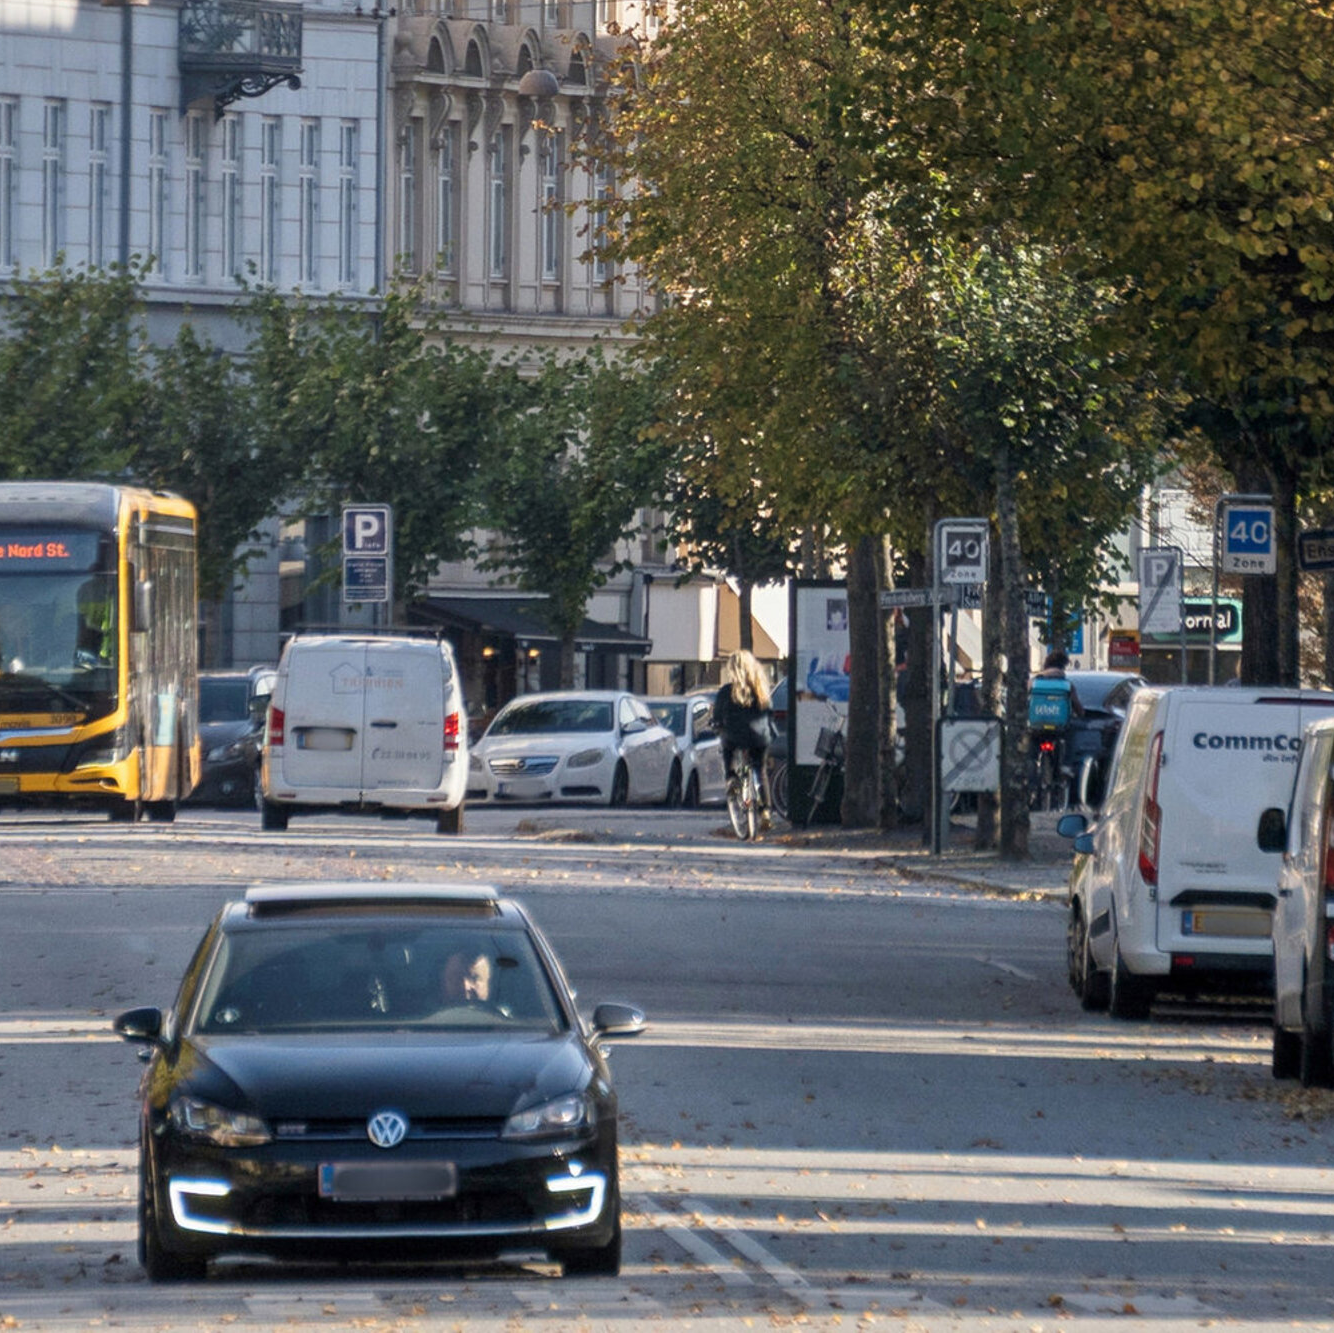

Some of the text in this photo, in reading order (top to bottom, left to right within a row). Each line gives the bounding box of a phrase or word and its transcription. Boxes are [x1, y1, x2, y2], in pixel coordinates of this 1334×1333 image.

[355, 514, 379, 549] P
[1230, 520, 1268, 544] 40
[8, 543, 42, 558] Nord
[46, 543, 70, 557] St.
[949, 539, 980, 559] 40
[1151, 559, 1169, 586] P
[1233, 557, 1266, 569] Zone
[950, 569, 977, 579] Zone
[1180, 610, 1231, 629] ormal
